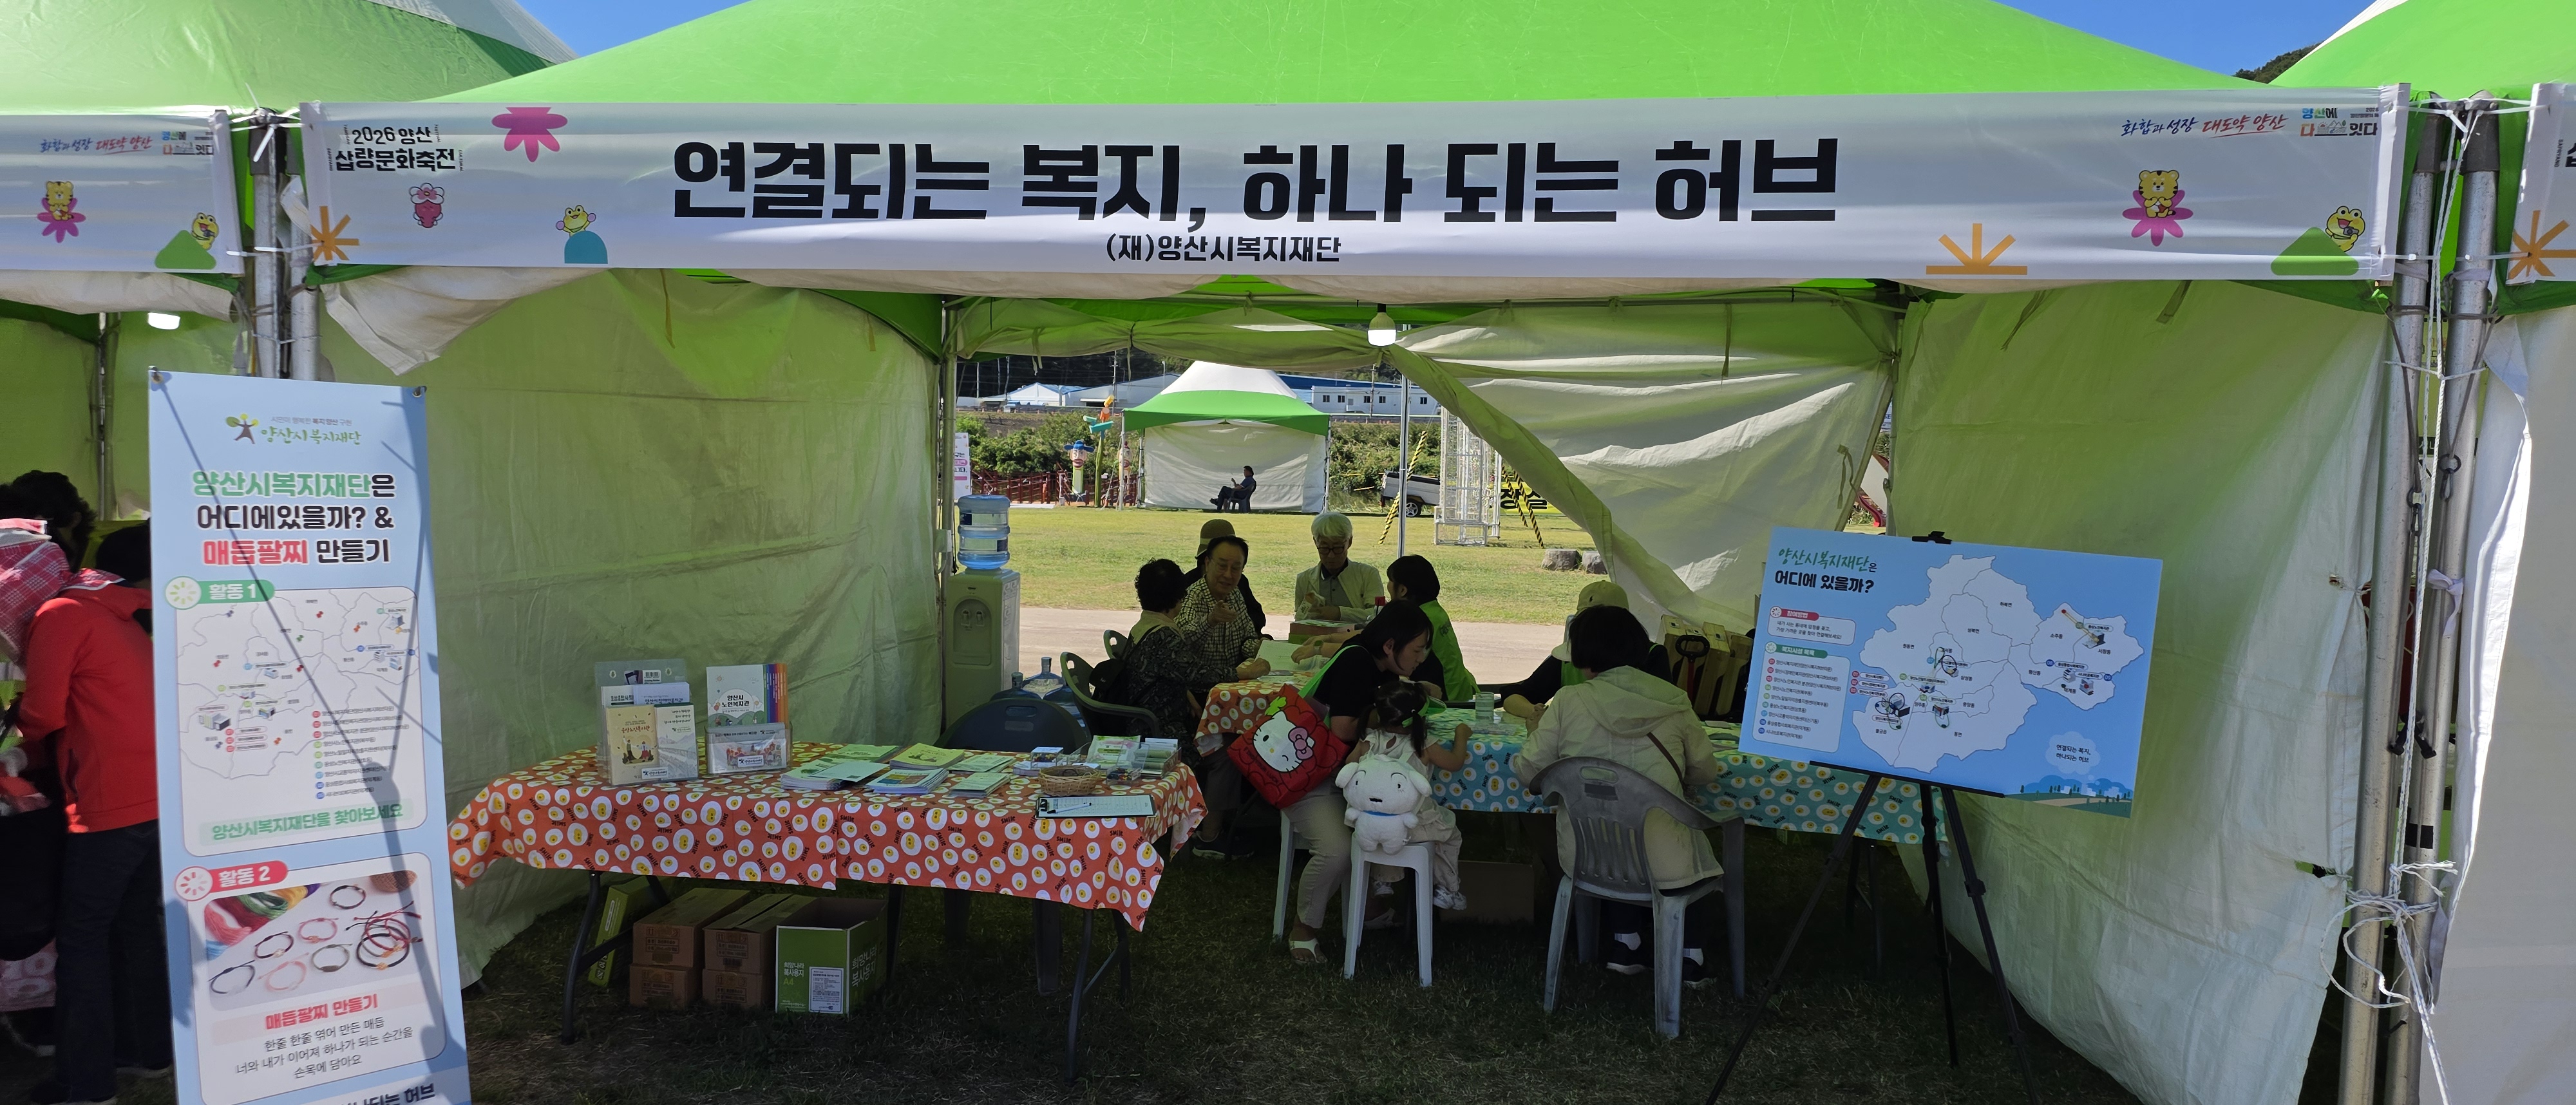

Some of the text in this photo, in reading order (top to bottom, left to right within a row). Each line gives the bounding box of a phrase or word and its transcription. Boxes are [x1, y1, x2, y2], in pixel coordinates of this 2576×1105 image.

[352, 126, 433, 145] 2026 양산
[2121, 113, 2289, 136] 화합과 성장 대도약 양산
[96, 137, 128, 150] 대도약
[129, 136, 153, 149] 양산
[336, 147, 456, 172] 삽량문화축전
[674, 138, 1839, 232] 연결되는 복지, 하나 되는 허브
[1106, 234, 1341, 263] (재)양산시복지재단
[261, 426, 361, 445] 양산시복지재단
[193, 472, 395, 498] 양산시복지재단은
[198, 505, 394, 529] 어디에있을까? &
[204, 539, 389, 565] 매듭팔찌 만들기
[1779, 548, 1877, 572] 양산시복지재단은
[209, 583, 256, 600] 활동 1
[1775, 570, 1875, 593] 어디에 있을까?
[2056, 744, 2077, 753] 연결되는
[2056, 753, 2077, 762] 하나되는
[213, 804, 404, 840] 양산시복지재단을 찾아보세요
[219, 867, 270, 886] 활동 2
[783, 978, 794, 986] A4
[784, 968, 804, 978] 복사용지
[851, 958, 876, 987] 복사용지
[265, 994, 379, 1030] 매듭팔찌 만들기
[265, 1038, 287, 1052] 한줄
[290, 1032, 312, 1047] 한줄
[339, 1023, 361, 1037] 만든
[364, 1017, 385, 1030] 매듭
[236, 1026, 413, 1074] 너와 내가 이어져 하나가 되는 순간을
[294, 1055, 362, 1079] 손목에 담아요
[404, 1083, 435, 1103] 허브
